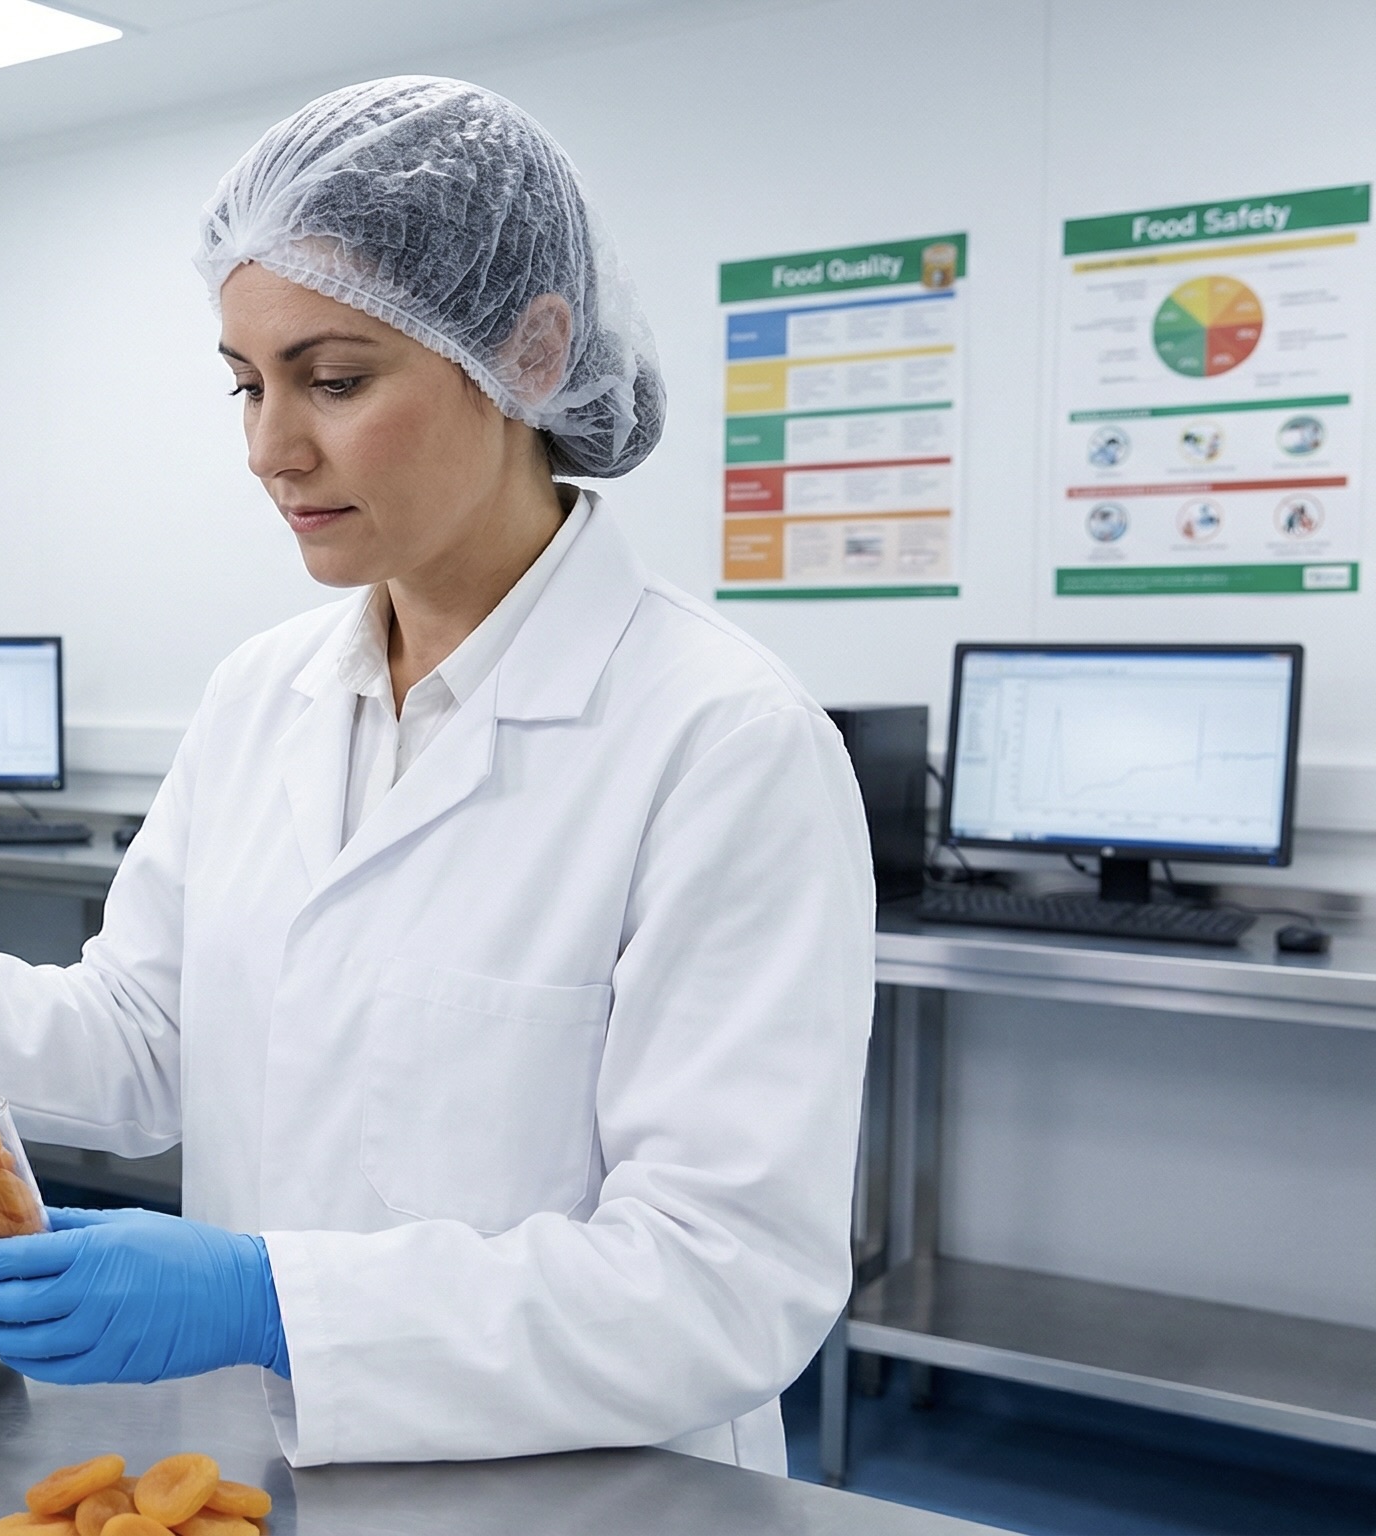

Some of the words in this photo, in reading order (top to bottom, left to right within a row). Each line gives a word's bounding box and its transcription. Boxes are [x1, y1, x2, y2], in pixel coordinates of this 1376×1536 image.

[1132, 211, 1197, 242] Food
[1203, 202, 1292, 232] Safety
[773, 261, 823, 288] Food
[826, 253, 904, 282] Quality
